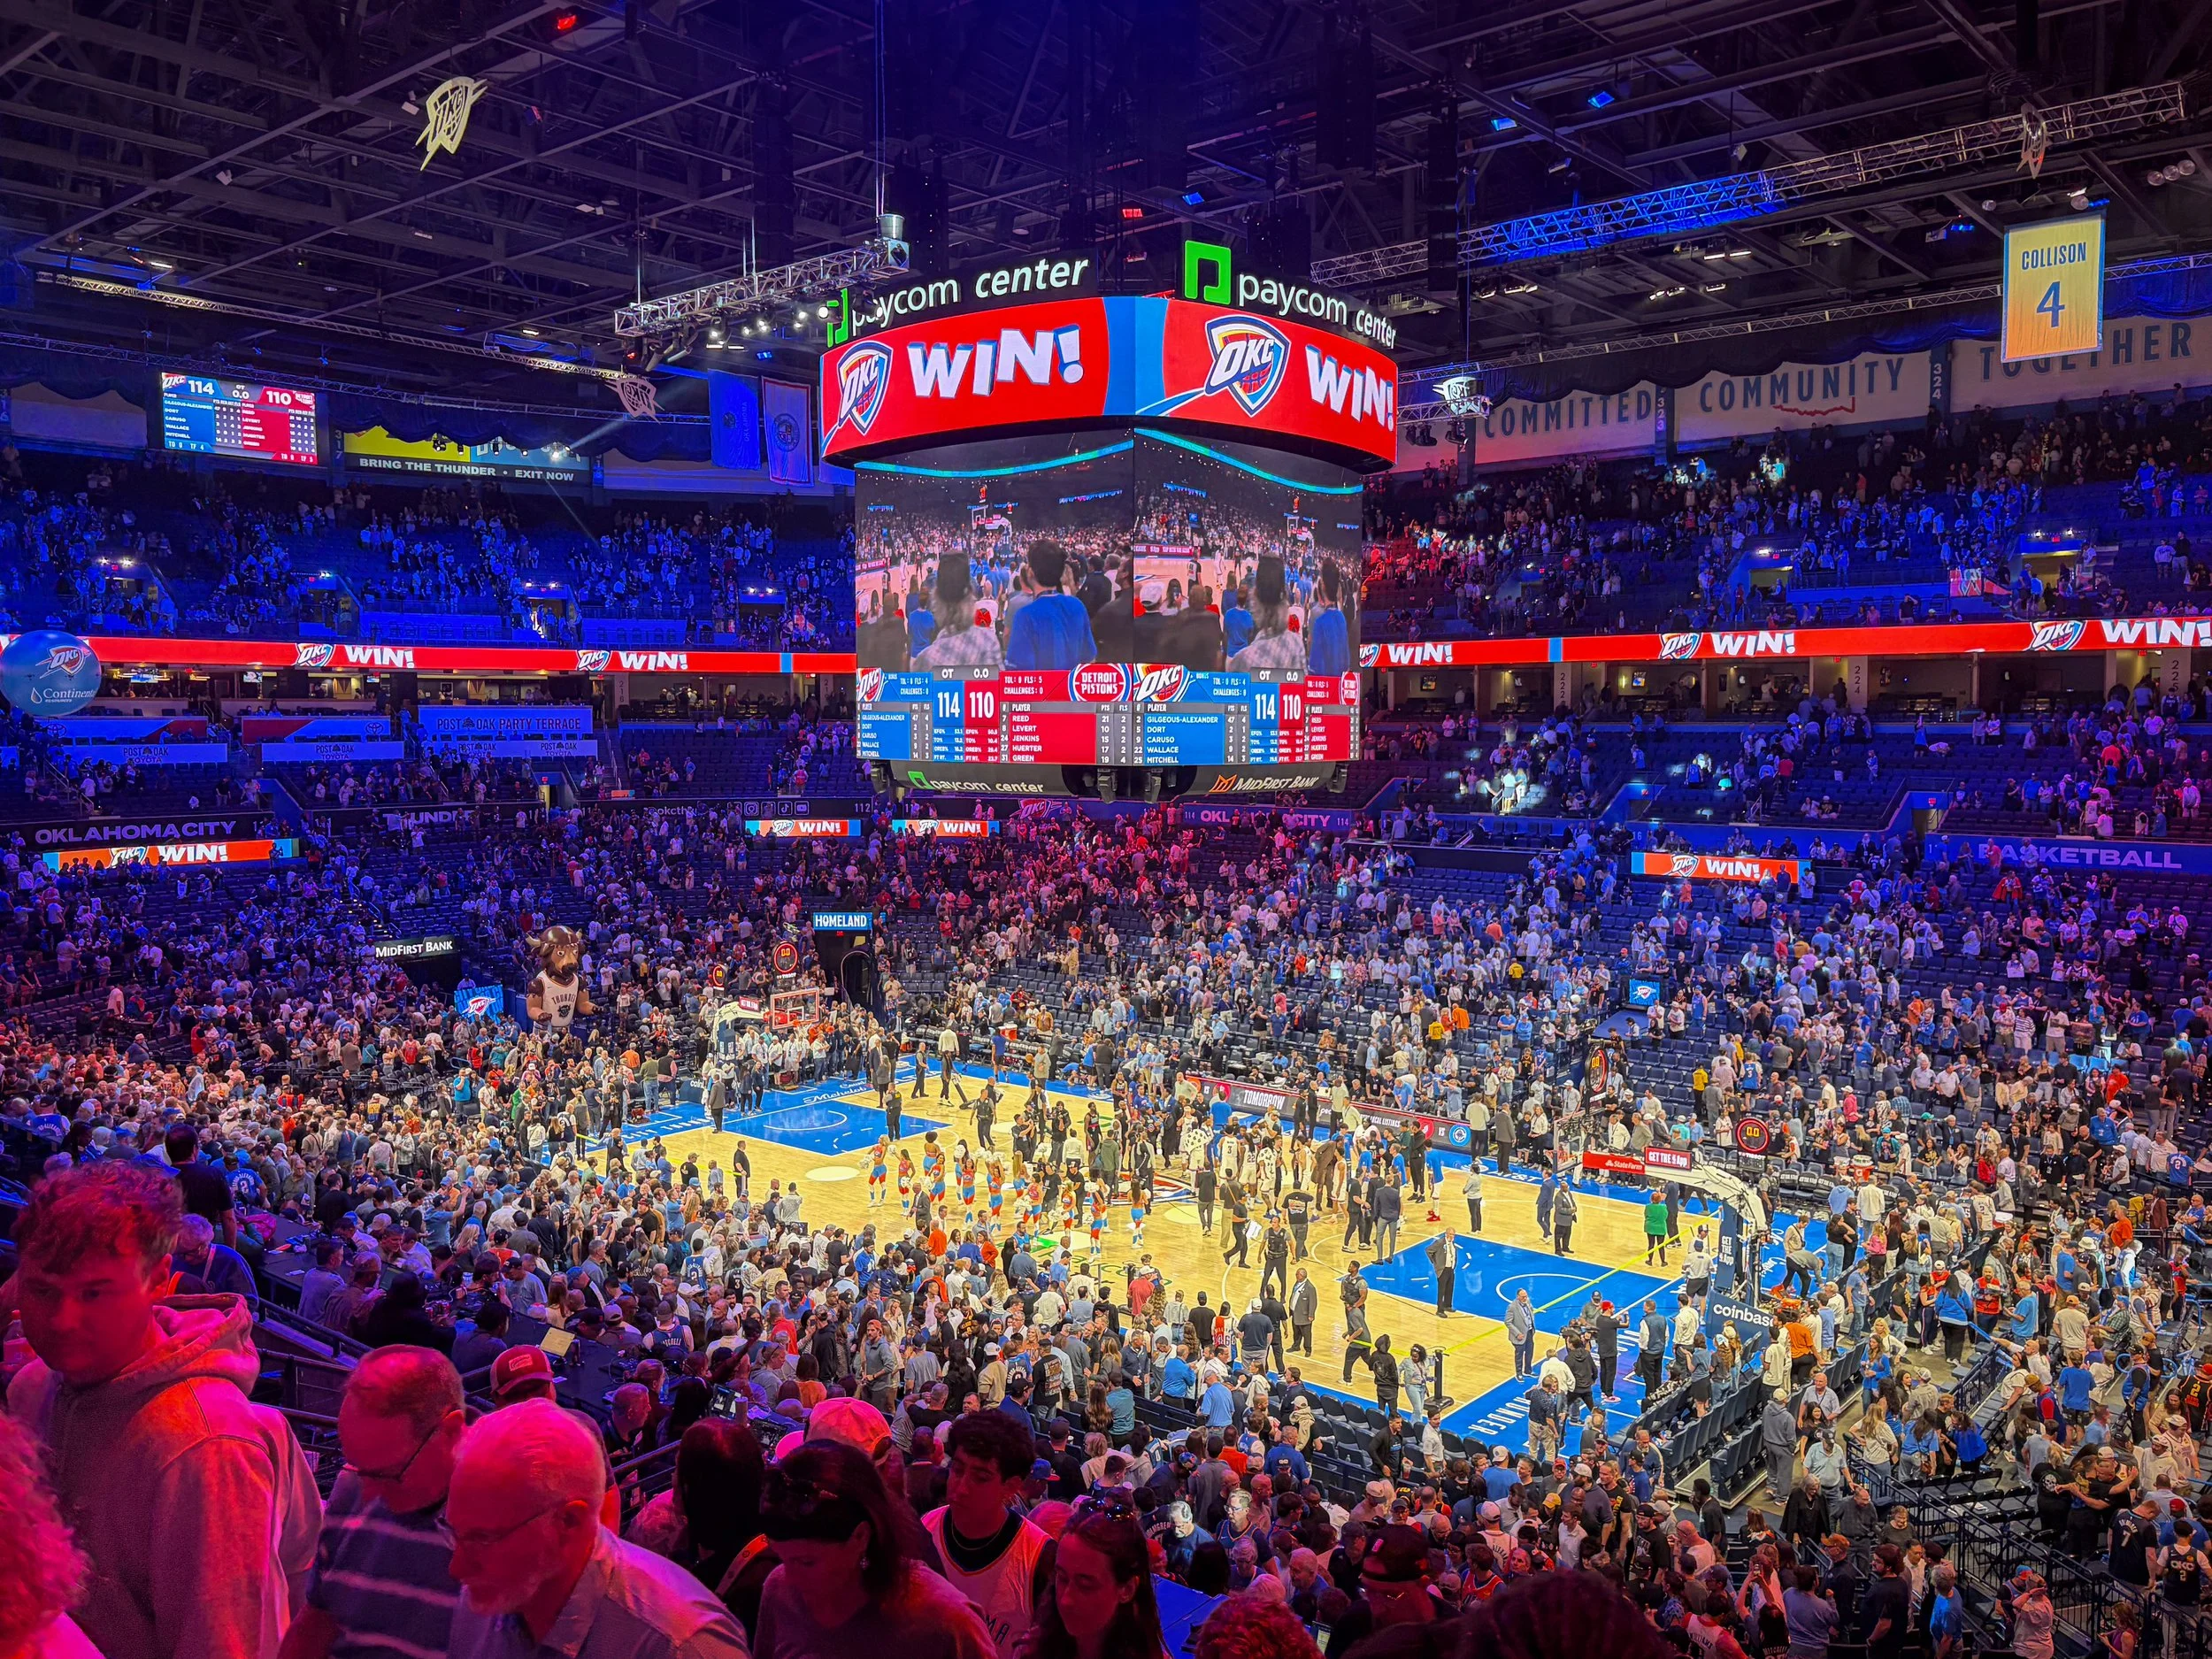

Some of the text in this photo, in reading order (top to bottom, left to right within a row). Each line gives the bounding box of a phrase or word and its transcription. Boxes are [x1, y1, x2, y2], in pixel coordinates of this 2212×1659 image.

[2021, 242, 2086, 270] COLLISON
[975, 258, 1089, 299] center
[1239, 273, 1396, 349] paycom center
[2036, 281, 2065, 328] 4
[907, 324, 1084, 398] WIN!
[188, 380, 215, 395] 114
[266, 390, 292, 405] 110
[232, 390, 250, 399] 0.0
[1210, 339, 1394, 432] OKC WIN!
[1700, 357, 1904, 412] COMMUNITY
[1484, 389, 1652, 439] COMMITTED
[359, 457, 574, 481] BRING THE THUNDER EXIT NOW
[2101, 619, 2212, 647] WIN!
[1387, 641, 1453, 665] WIN!
[1711, 631, 1795, 657] WIN!
[345, 645, 415, 668] WIN!
[618, 651, 688, 671] WIN!
[941, 668, 989, 679] OT 0.0
[1081, 672, 1118, 683] DETROIT
[1136, 665, 1181, 702] OKC
[1260, 671, 1298, 681] OT 0.0
[1081, 684, 1118, 695] PISTONS
[937, 691, 995, 718] 114 110
[1255, 694, 1301, 719] 114 110
[437, 718, 581, 730] POST OAK PARTY TERRACE
[123, 747, 169, 757] POST OAK
[316, 744, 354, 753] POST OAK
[930, 780, 1044, 793] paycom center
[855, 803, 871, 813] 112
[35, 821, 236, 844] OKLAHOMA CITY
[798, 822, 841, 833] WIN!
[944, 821, 980, 833] WIN!
[157, 844, 227, 862] WIN!
[1705, 859, 1761, 879] WIN!
[815, 915, 868, 927] HOMELAND
[1243, 1089, 1285, 1110] TOMORROW
[1247, 1154, 1255, 1163] 22
[1722, 1236, 1732, 1245] GET
[1722, 1245, 1732, 1255] THE
[734, 1279, 741, 1289] 3
[1713, 1304, 1773, 1327] coinbas
[2191, 1383, 2200, 1397] 2
[2121, 1532, 2131, 1548] 7
